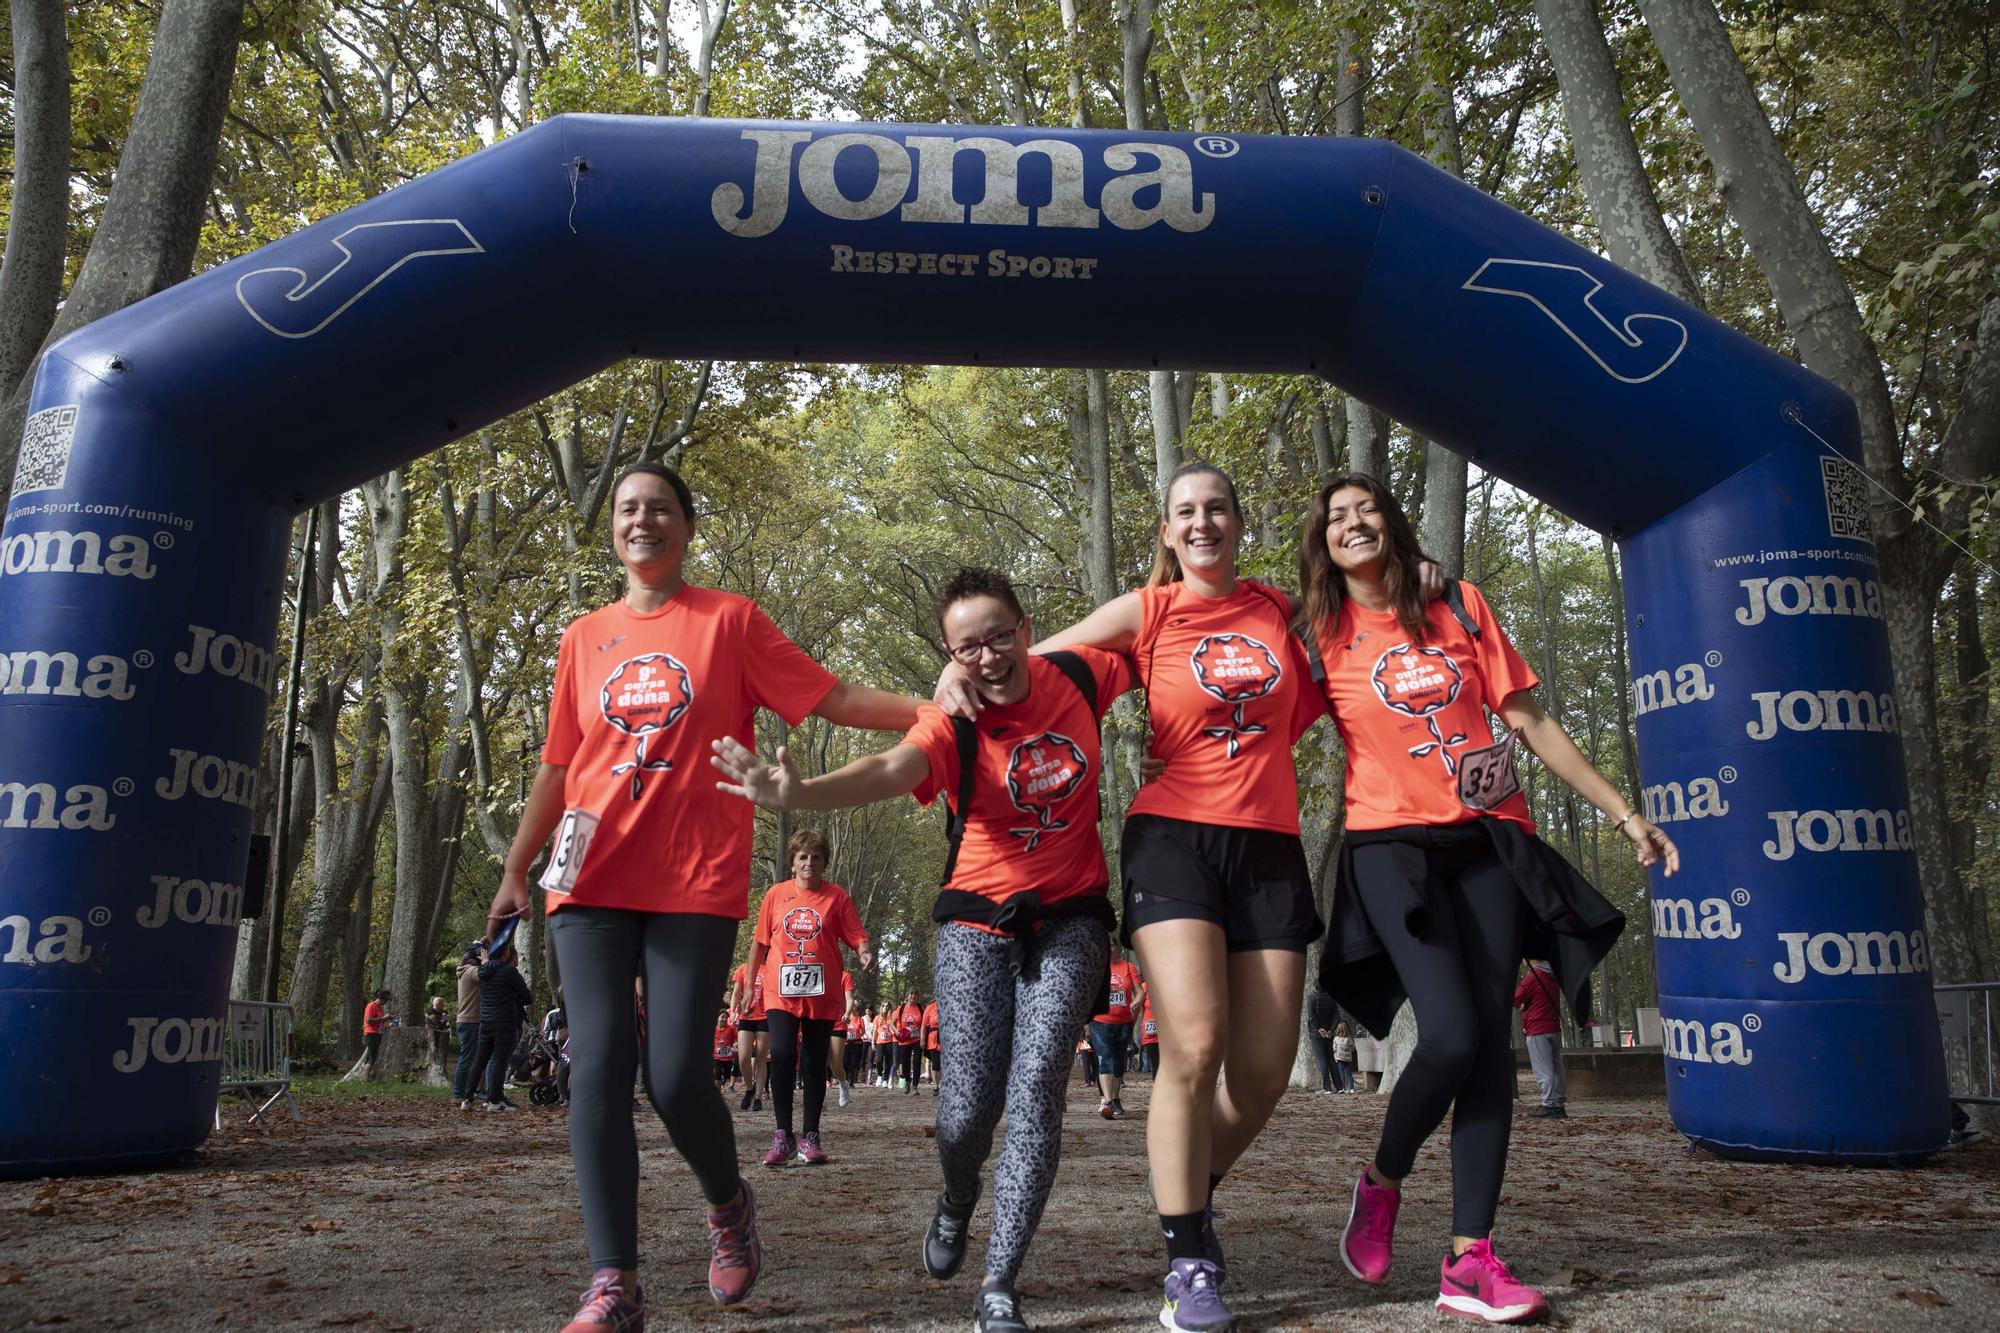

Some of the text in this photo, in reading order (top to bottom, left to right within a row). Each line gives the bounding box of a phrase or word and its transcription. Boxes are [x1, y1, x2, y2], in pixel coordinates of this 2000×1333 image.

[831, 245, 1098, 280] RESPECT SPORT
[1213, 665, 1263, 678] dona
[1394, 673, 1446, 693] dona
[617, 690, 671, 707] dona
[1027, 767, 1072, 795] dona
[784, 971, 819, 987] 1871
